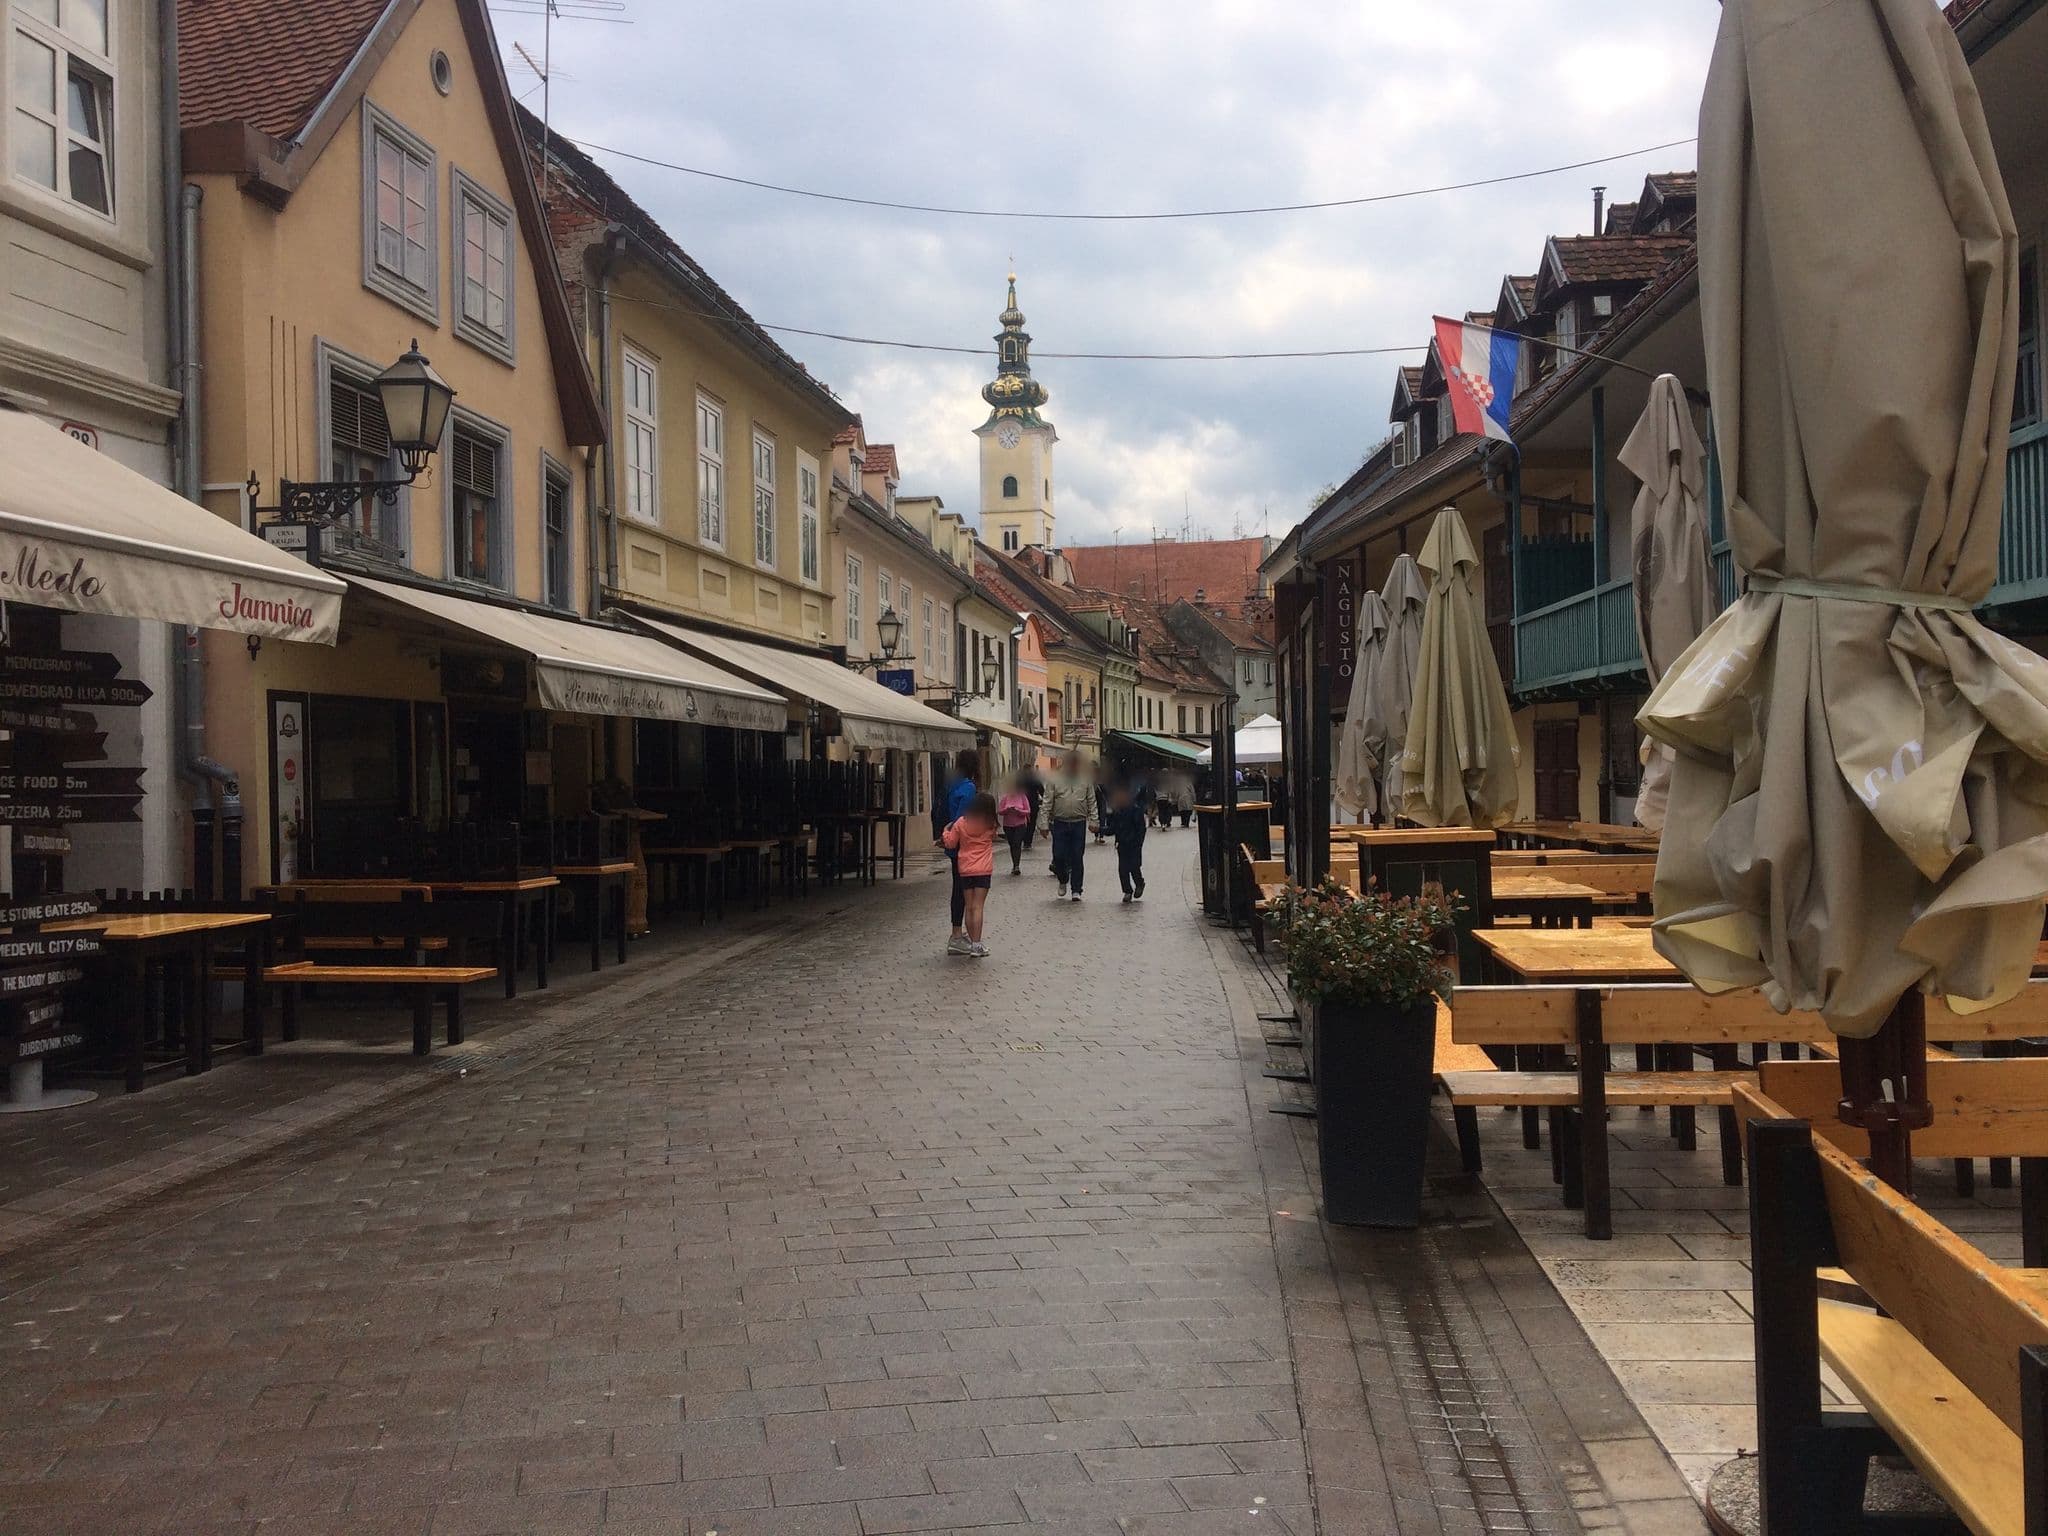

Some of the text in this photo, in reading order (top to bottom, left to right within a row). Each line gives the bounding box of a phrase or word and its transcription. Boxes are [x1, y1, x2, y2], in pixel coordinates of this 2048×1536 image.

[1, 546, 106, 597] Medo
[219, 583, 314, 629] Jamnica
[1336, 565, 1352, 678] NAGUSTO
[111, 688, 144, 702] 900m
[23, 776, 58, 788] FOOD
[65, 776, 88, 788] 5m
[0, 805, 82, 819] PIZZERIA 25m
[8, 905, 43, 922] STONE
[44, 903, 70, 918] GATE
[70, 901, 98, 914] 250m
[48, 939, 75, 954] CITY
[75, 938, 99, 951] 6km
[2, 976, 17, 991] THE
[17, 972, 46, 990] BLOODY
